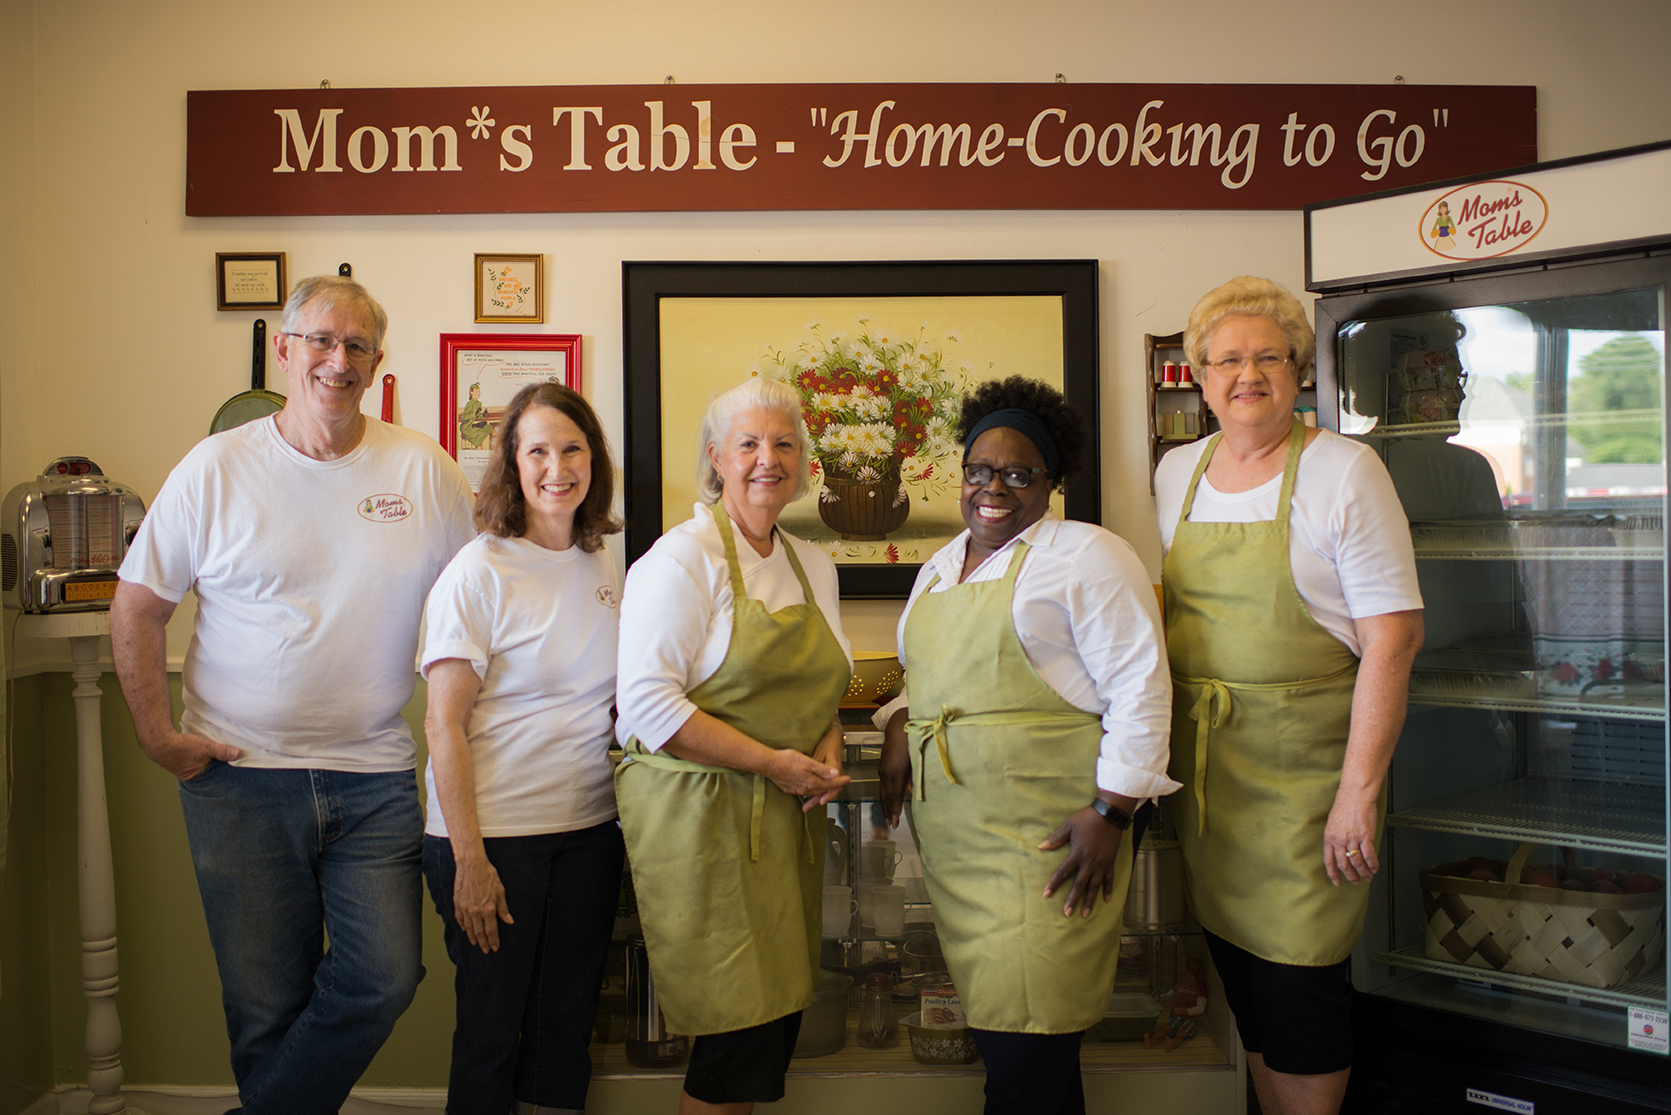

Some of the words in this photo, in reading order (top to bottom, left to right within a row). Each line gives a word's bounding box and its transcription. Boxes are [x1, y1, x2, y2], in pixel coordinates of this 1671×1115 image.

[552, 100, 758, 173] Table
[1280, 112, 1336, 168] to
[1467, 210, 1534, 250] Table
[380, 506, 408, 519] Table
[924, 998, 946, 1006] Poultry
